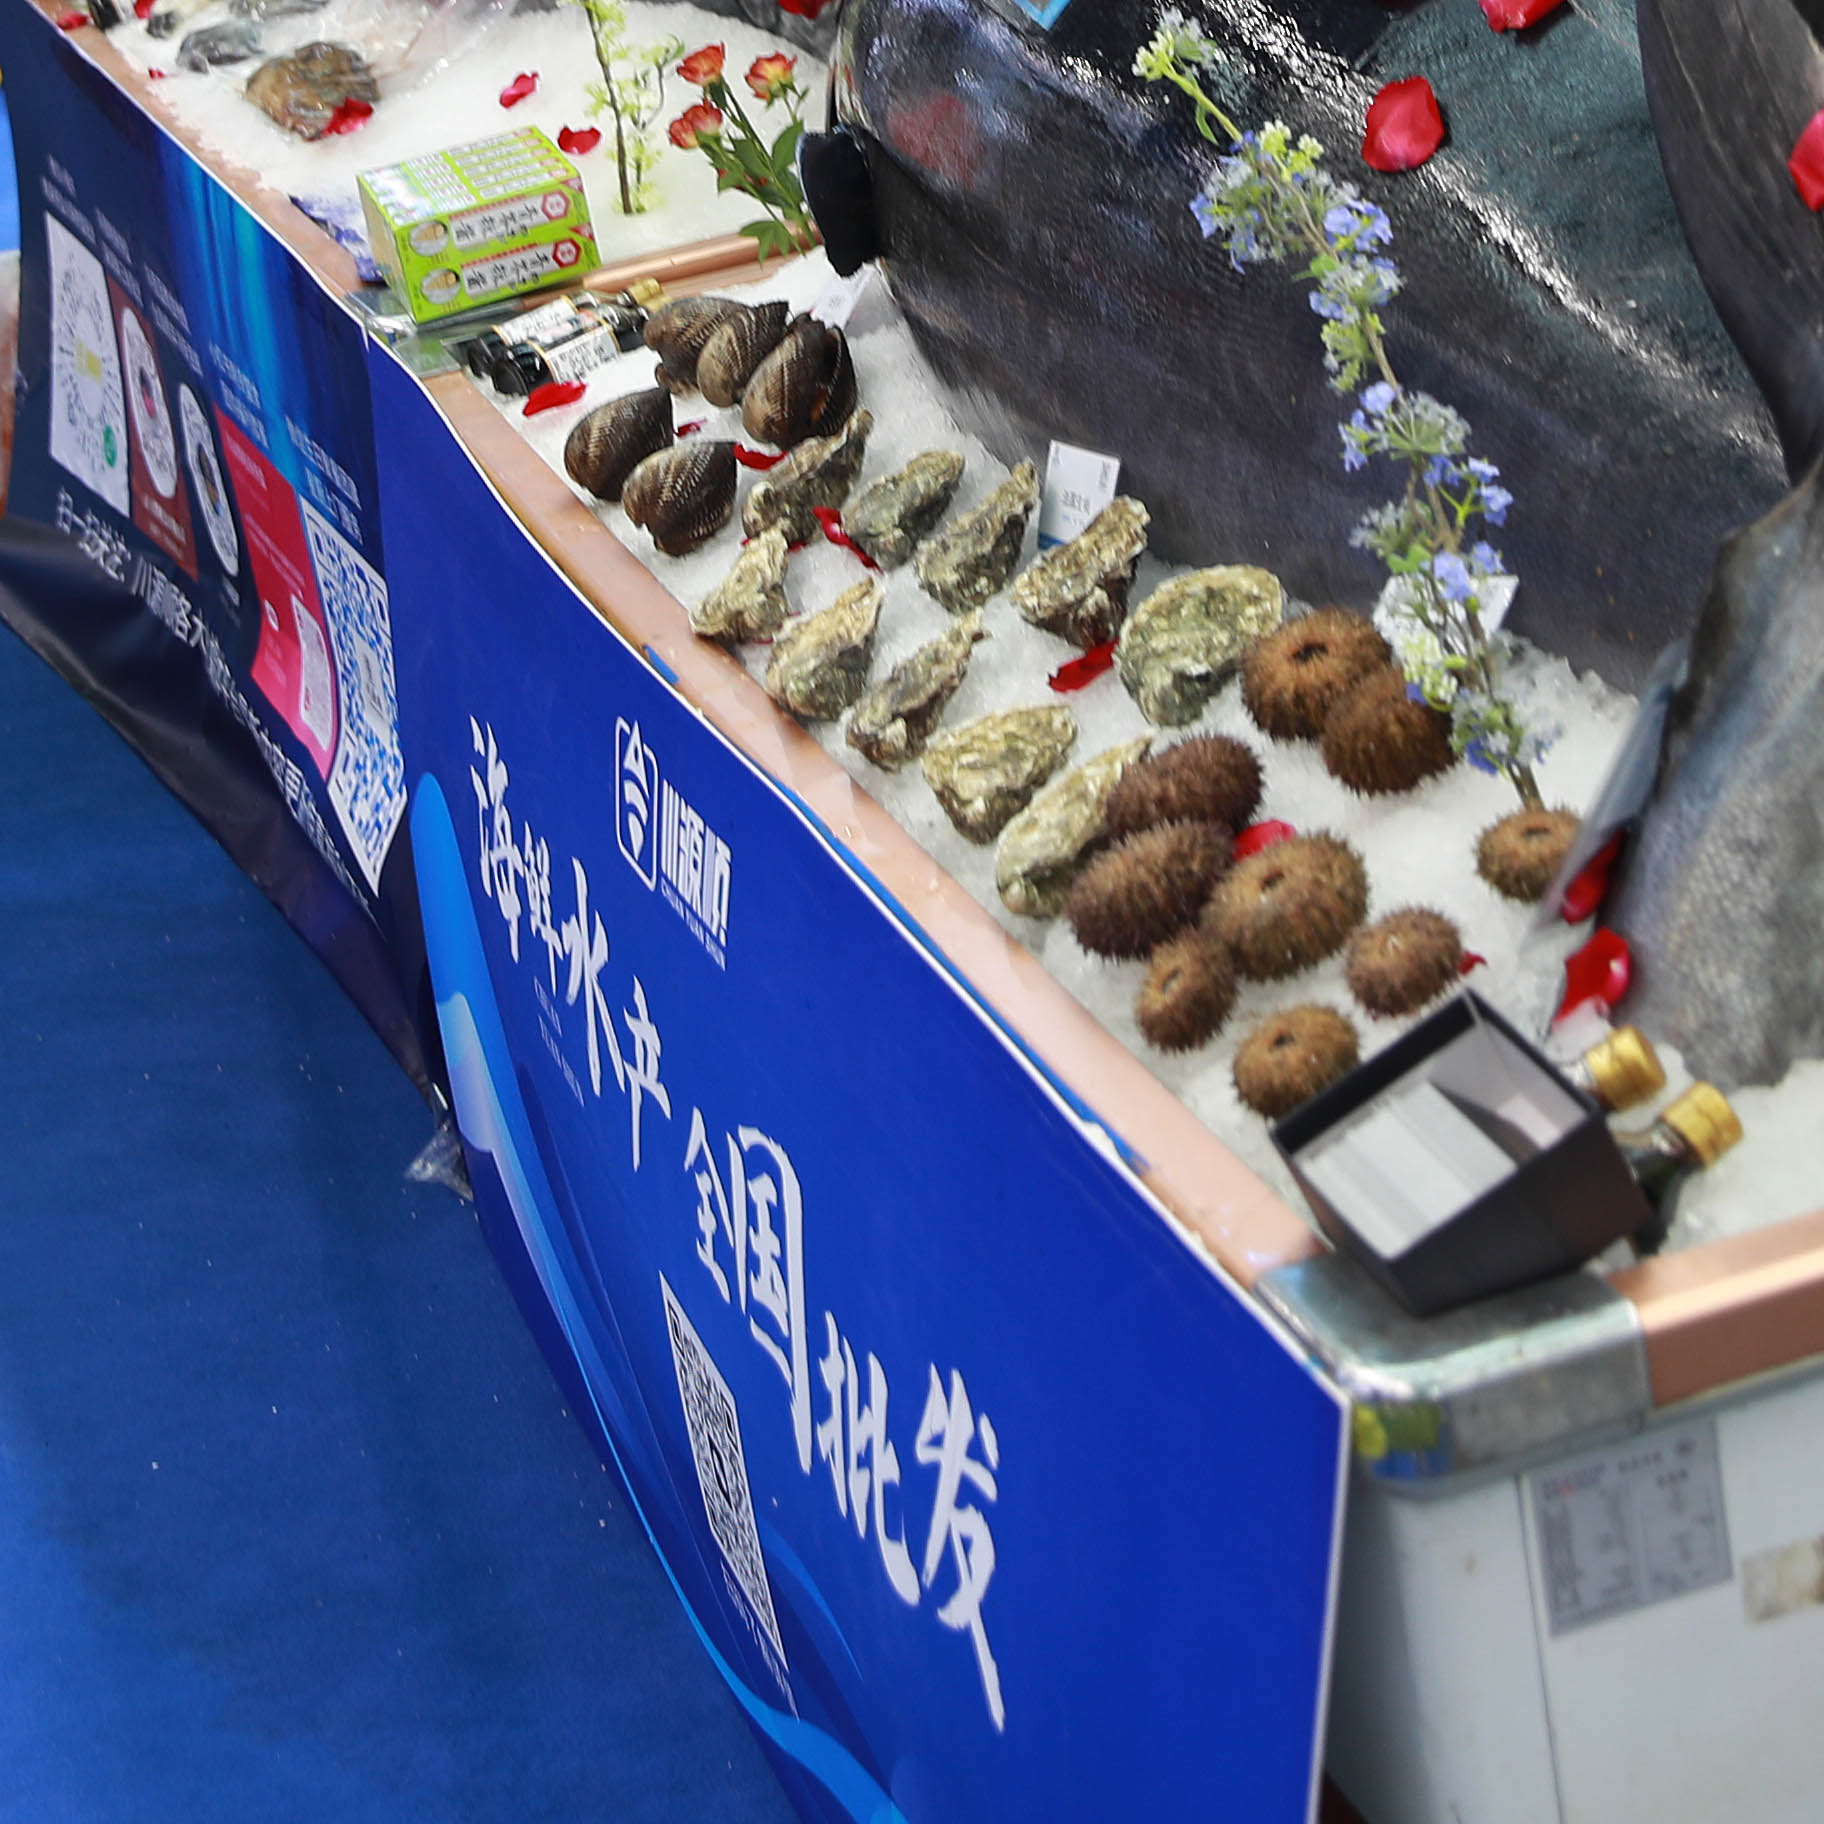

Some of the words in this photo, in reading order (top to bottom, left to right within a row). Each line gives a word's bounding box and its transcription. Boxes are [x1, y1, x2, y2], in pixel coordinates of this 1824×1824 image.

[470, 714, 672, 1171] 海鲜水产
[686, 1105, 1006, 1733] 全国批发
